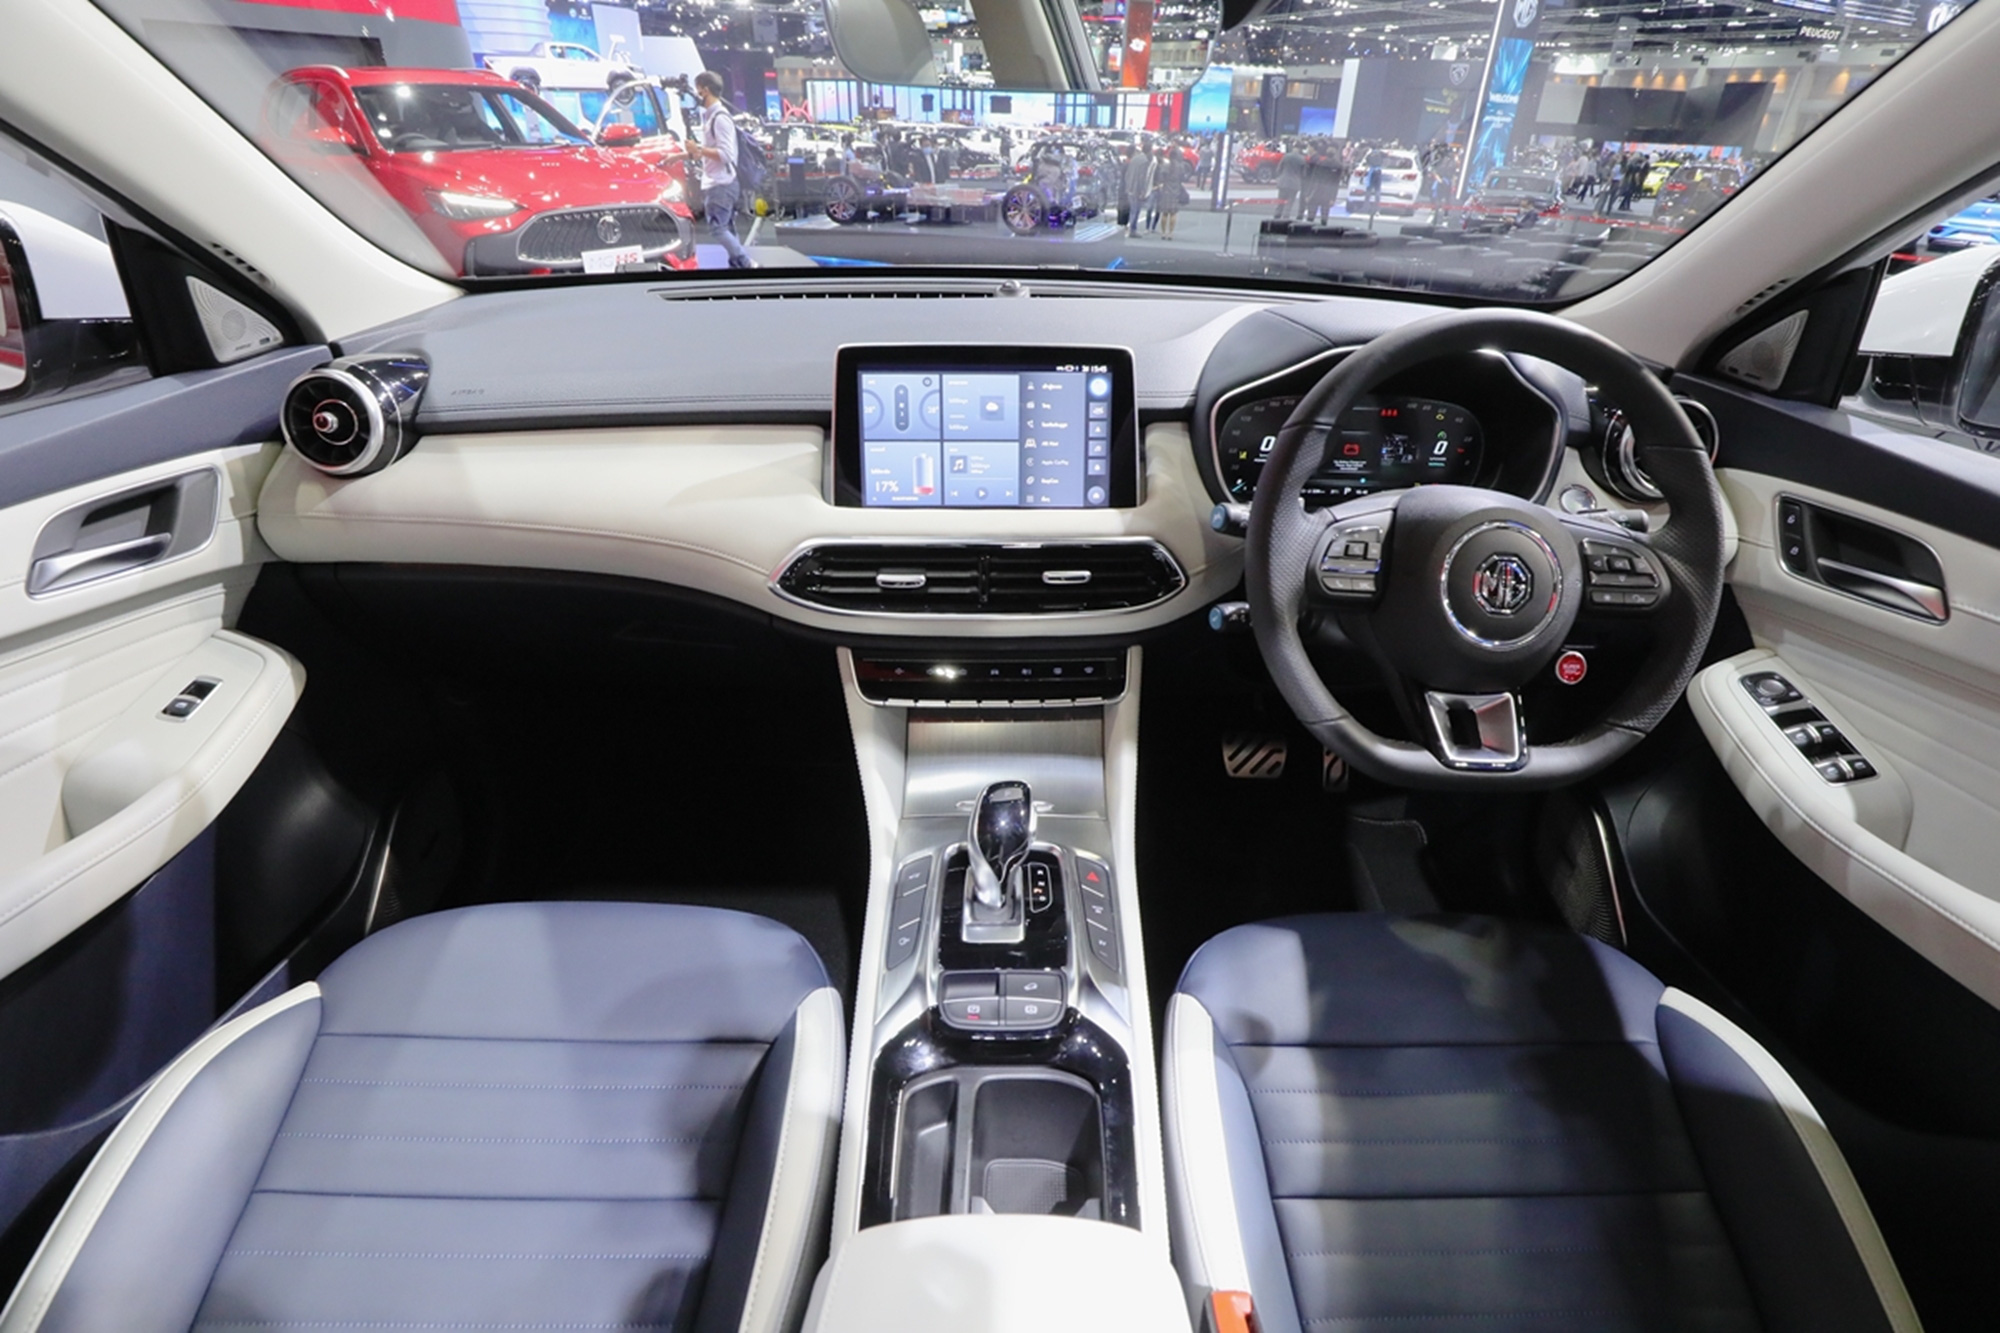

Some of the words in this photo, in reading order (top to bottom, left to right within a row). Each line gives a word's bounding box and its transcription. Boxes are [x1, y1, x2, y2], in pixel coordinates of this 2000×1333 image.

[1799, 25, 1842, 41] PEUGEOT
[1489, 91, 1520, 104] WELCOME
[1260, 435, 1276, 452] 0
[1433, 440, 1448, 455] 0
[875, 480, 900, 493] 17%
[1480, 560, 1528, 610] MG
